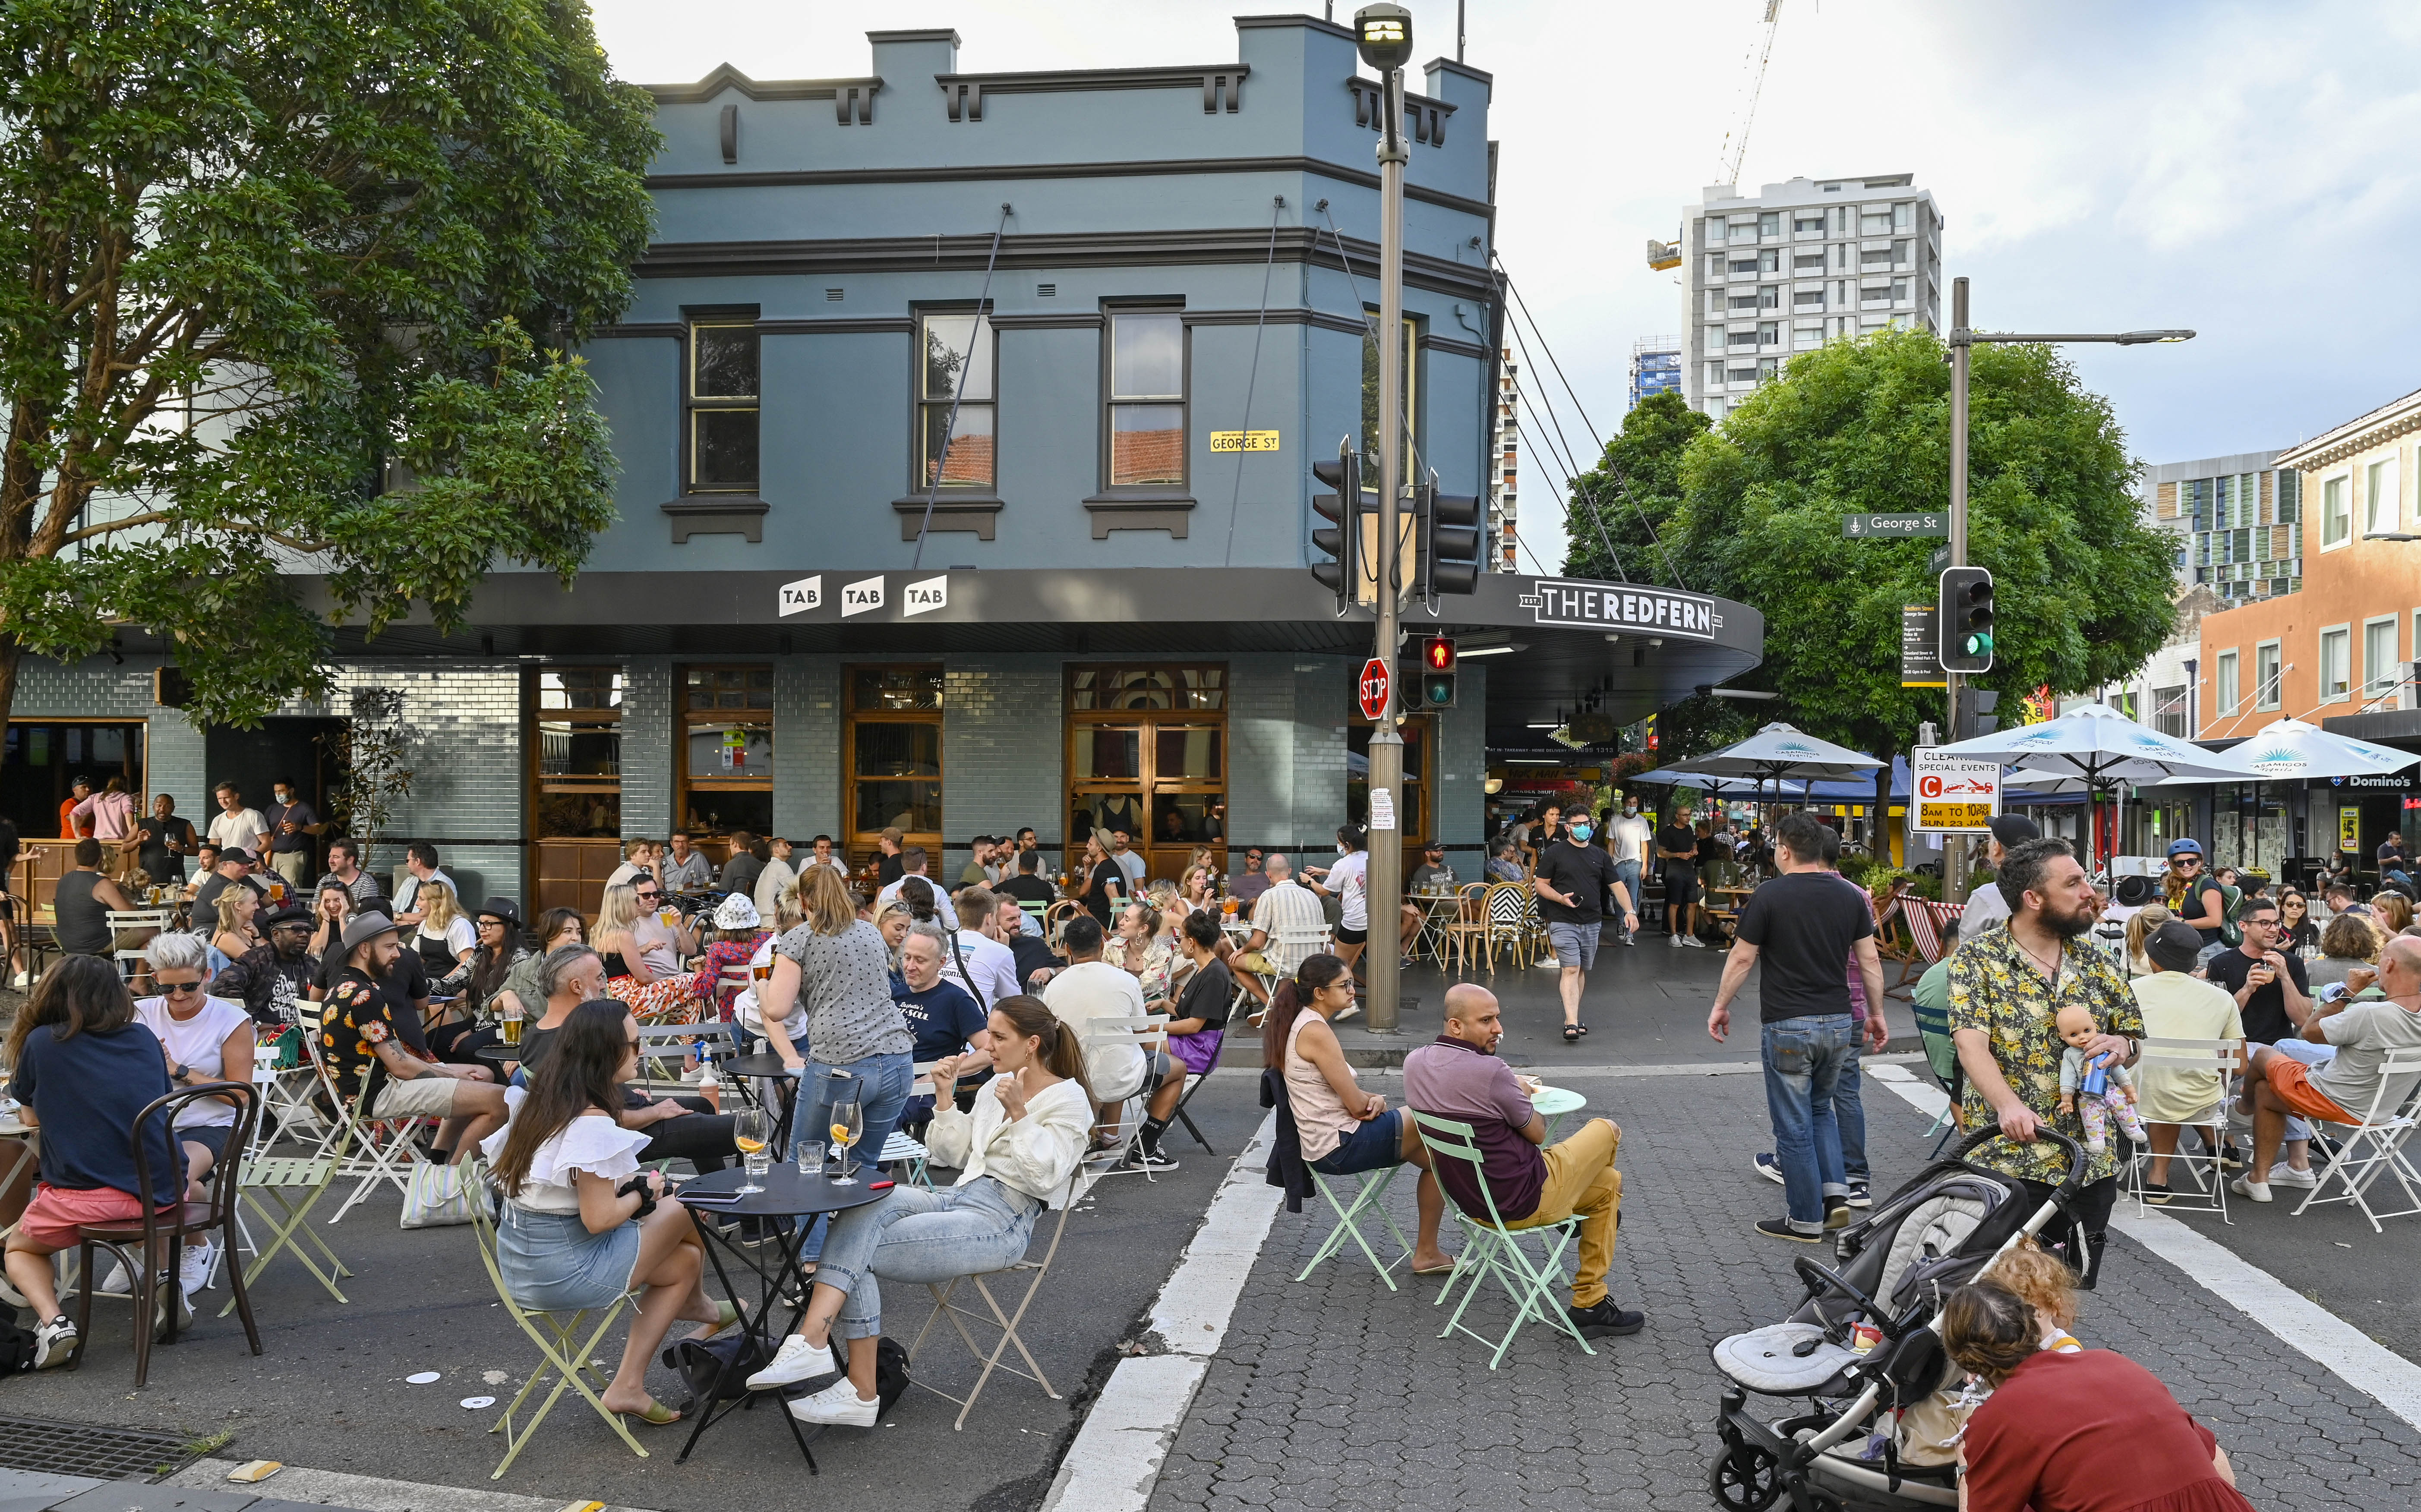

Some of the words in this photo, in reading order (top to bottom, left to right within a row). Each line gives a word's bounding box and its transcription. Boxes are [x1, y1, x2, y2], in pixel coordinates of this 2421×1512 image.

[1213, 438, 1257, 449] GEORGE
[1871, 517, 1919, 531] George
[1924, 516, 1937, 528] St
[784, 590, 818, 604] TAB
[846, 590, 880, 604] TAB
[909, 590, 942, 604] TAB
[1541, 589, 1597, 618] THE
[1603, 592, 1709, 633] REDFERN
[1362, 677, 1386, 701] STOP
[1535, 769, 1560, 778] MAN
[1925, 778, 1938, 796] C
[2350, 775, 2411, 787] Domino's
[1921, 804, 1942, 816] 8AM
[1949, 808, 1963, 816] TO
